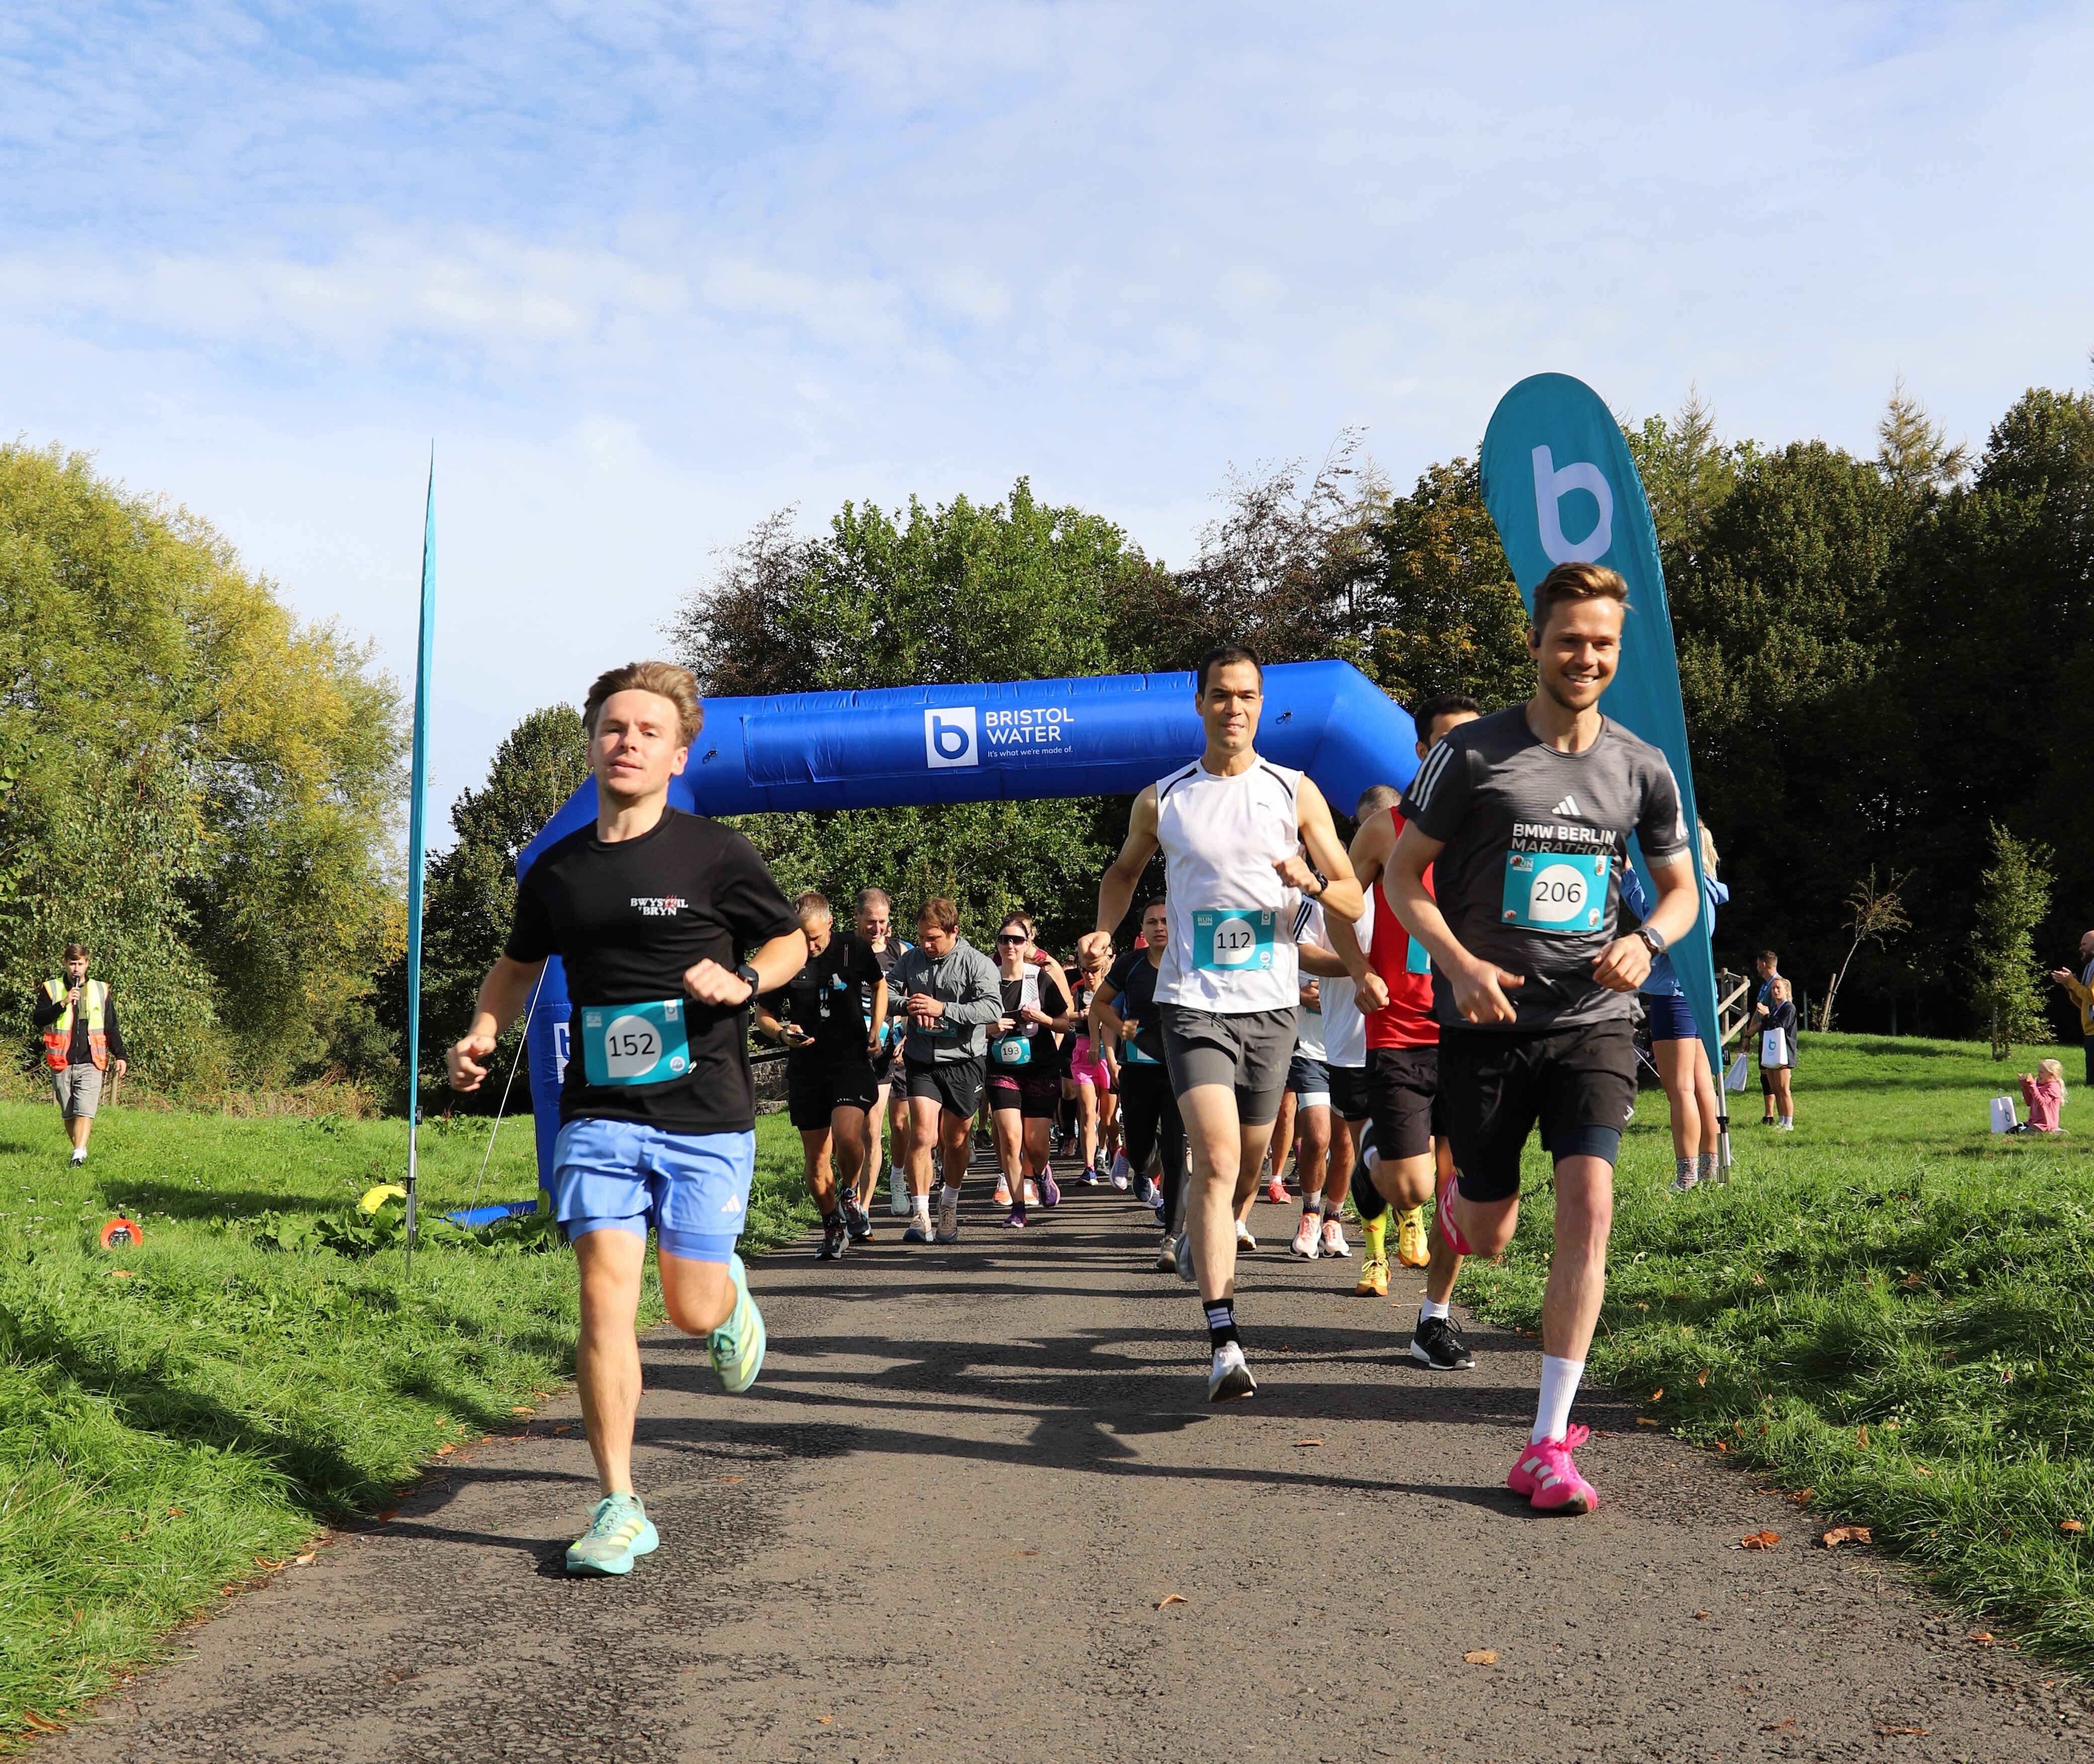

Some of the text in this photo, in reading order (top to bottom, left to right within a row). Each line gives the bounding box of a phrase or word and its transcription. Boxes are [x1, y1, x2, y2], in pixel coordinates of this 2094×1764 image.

[985, 707, 1075, 727] BRISTOL
[987, 725, 1062, 745] WATER
[1041, 746, 1063, 754] made
[1513, 823, 1617, 845] BMW BERLIN
[1512, 837, 1613, 856] MARATHON
[1535, 881, 1582, 903] 206
[643, 906, 677, 916] BRYN
[1217, 932, 1251, 949] 112
[609, 1033, 655, 1056] 152
[1003, 1047, 1019, 1055] 193
